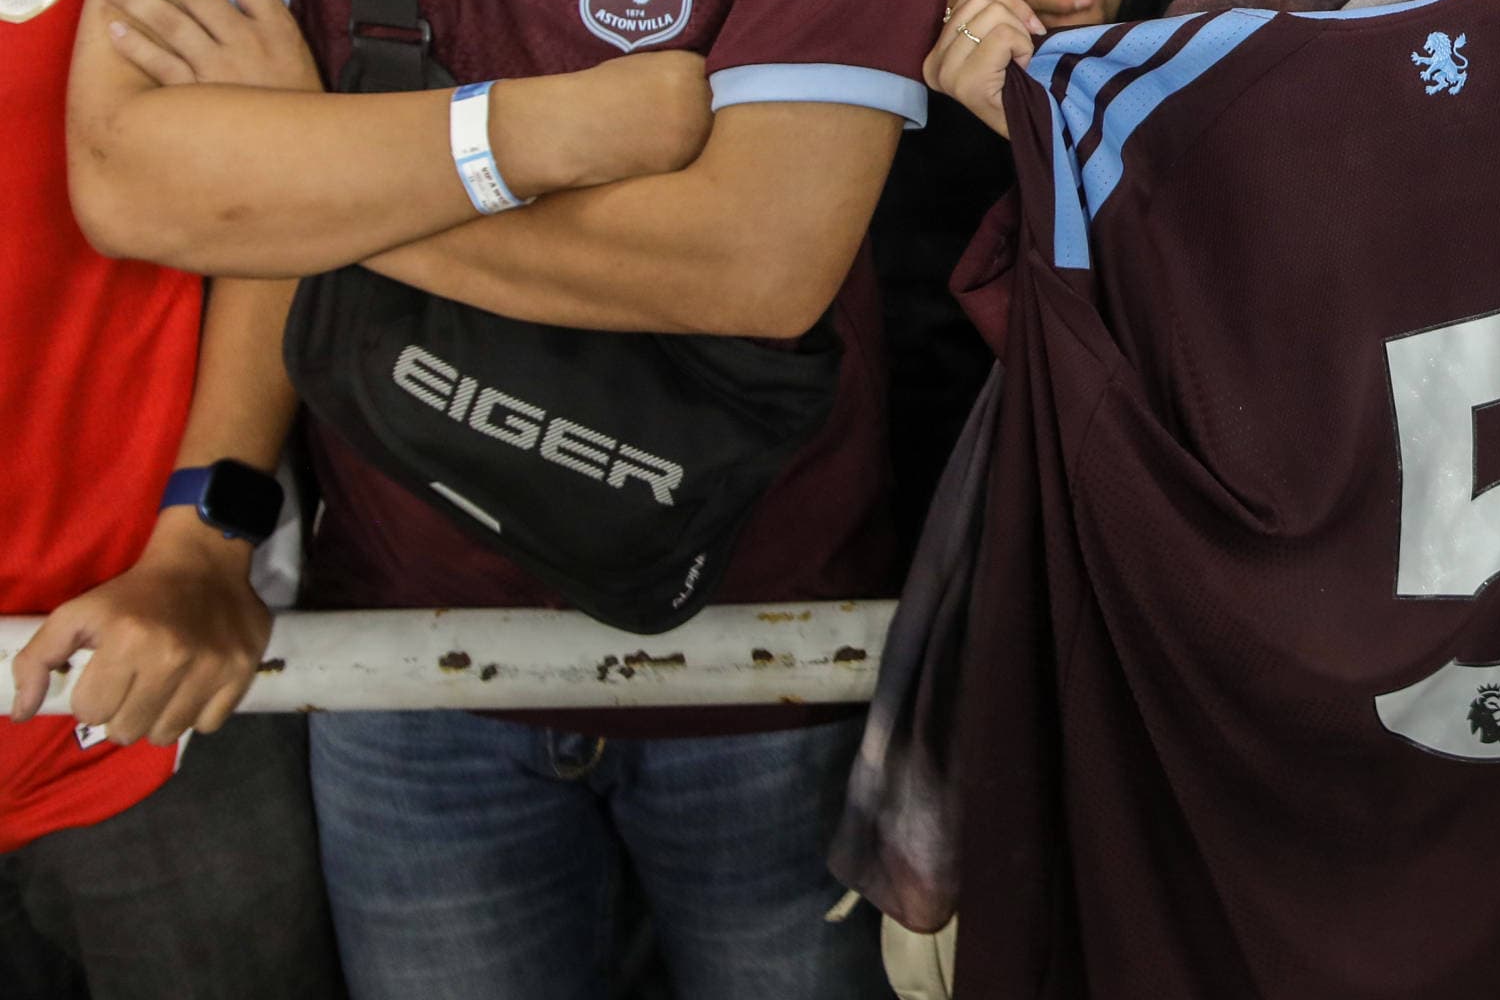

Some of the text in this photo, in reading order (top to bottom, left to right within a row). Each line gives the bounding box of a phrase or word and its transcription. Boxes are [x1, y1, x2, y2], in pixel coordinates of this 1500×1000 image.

[595, 8, 674, 32] ASTON VILLA
[625, 8, 645, 17] 1874
[393, 344, 684, 506] EIGER
